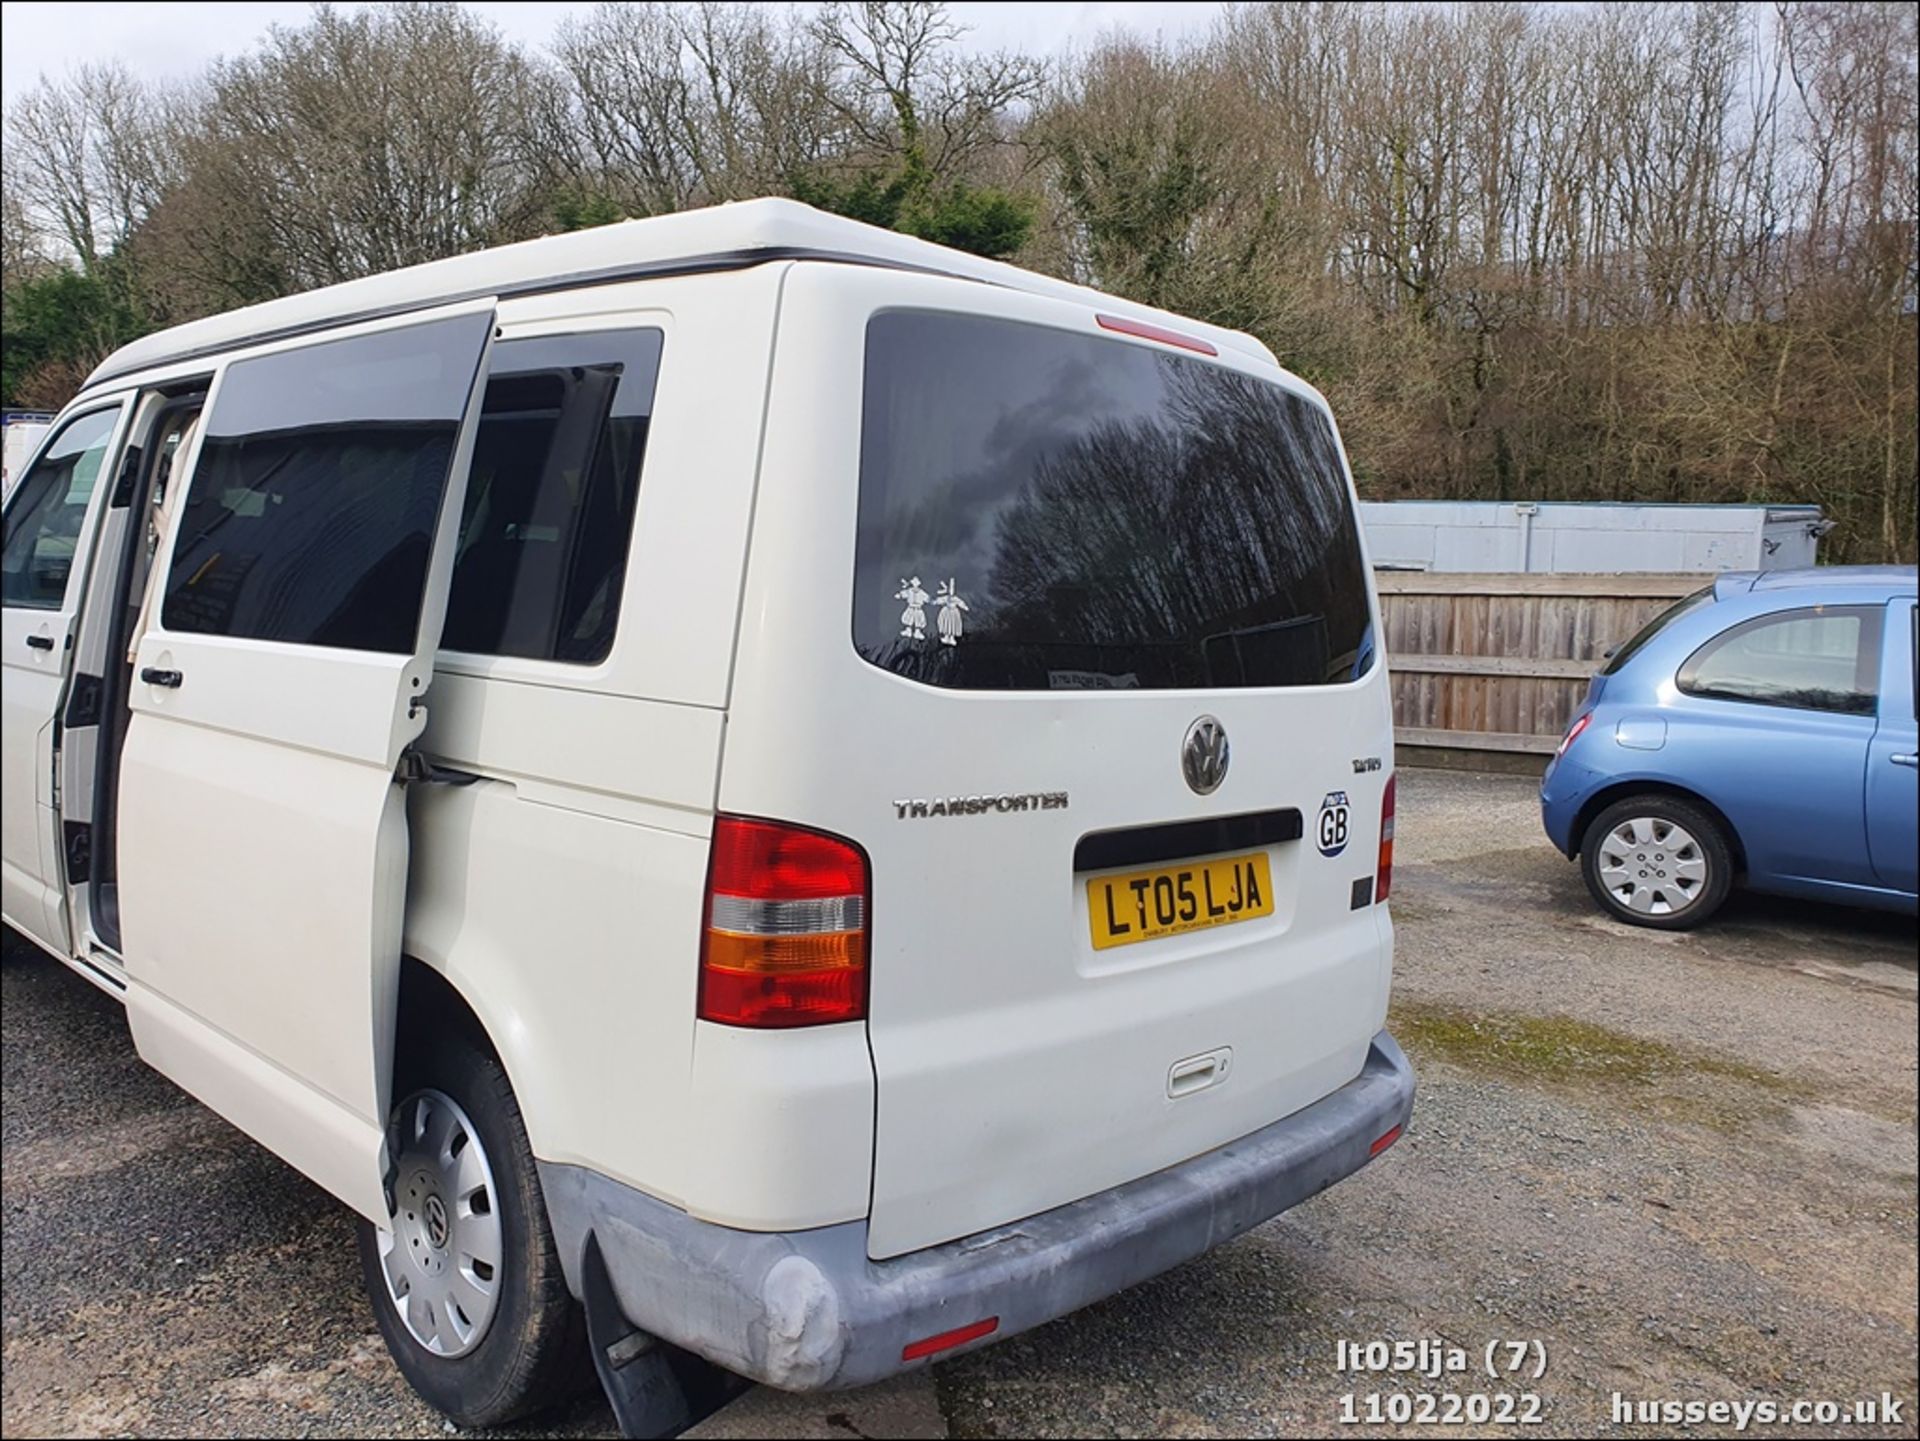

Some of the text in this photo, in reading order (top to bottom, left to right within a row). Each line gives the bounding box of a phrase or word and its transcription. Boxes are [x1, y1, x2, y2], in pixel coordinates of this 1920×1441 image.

[893, 791, 1070, 820] TRANSPORTER
[1321, 807, 1348, 847] GB
[1105, 861, 1263, 936] LT05 LJA
